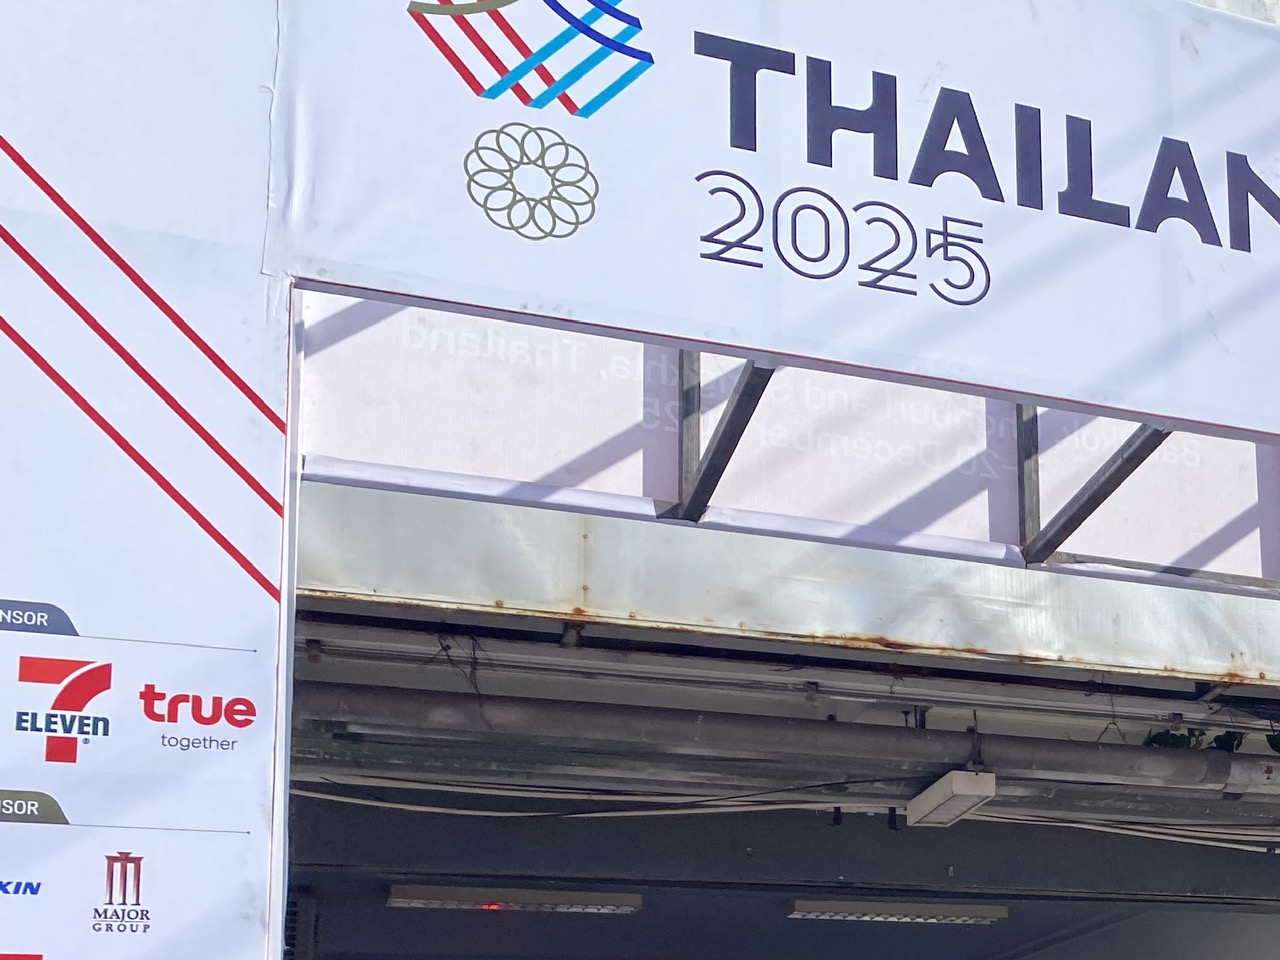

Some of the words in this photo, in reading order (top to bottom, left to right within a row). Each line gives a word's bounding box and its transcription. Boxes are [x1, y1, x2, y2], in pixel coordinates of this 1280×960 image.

[694, 170, 990, 306] 2025
[139, 684, 257, 728] true
[161, 734, 238, 751] together
[0, 799, 39, 815] SOR
[92, 908, 150, 922] MAJOR
[92, 923, 150, 933] GROUP
